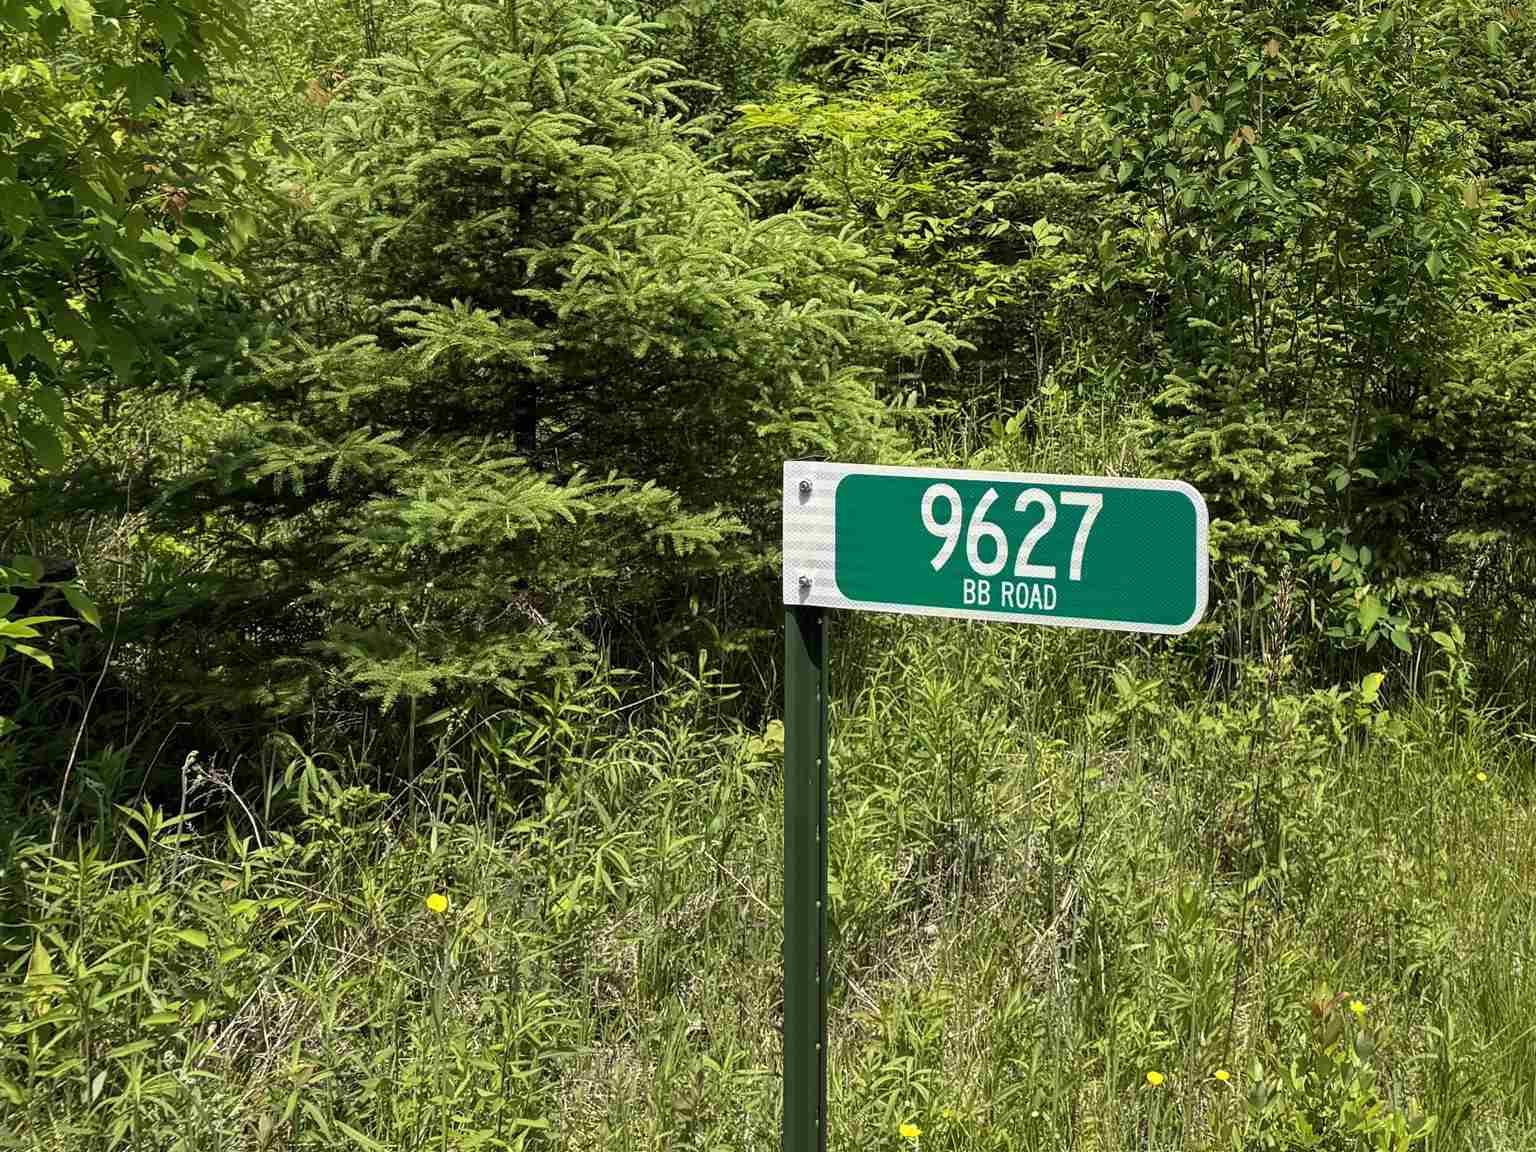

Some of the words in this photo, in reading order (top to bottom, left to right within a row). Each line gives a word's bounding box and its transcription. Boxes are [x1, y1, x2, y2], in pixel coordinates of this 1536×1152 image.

[920, 483, 1104, 581] 9627
[963, 578, 991, 606] BB
[1001, 581, 1057, 611] ROAD
